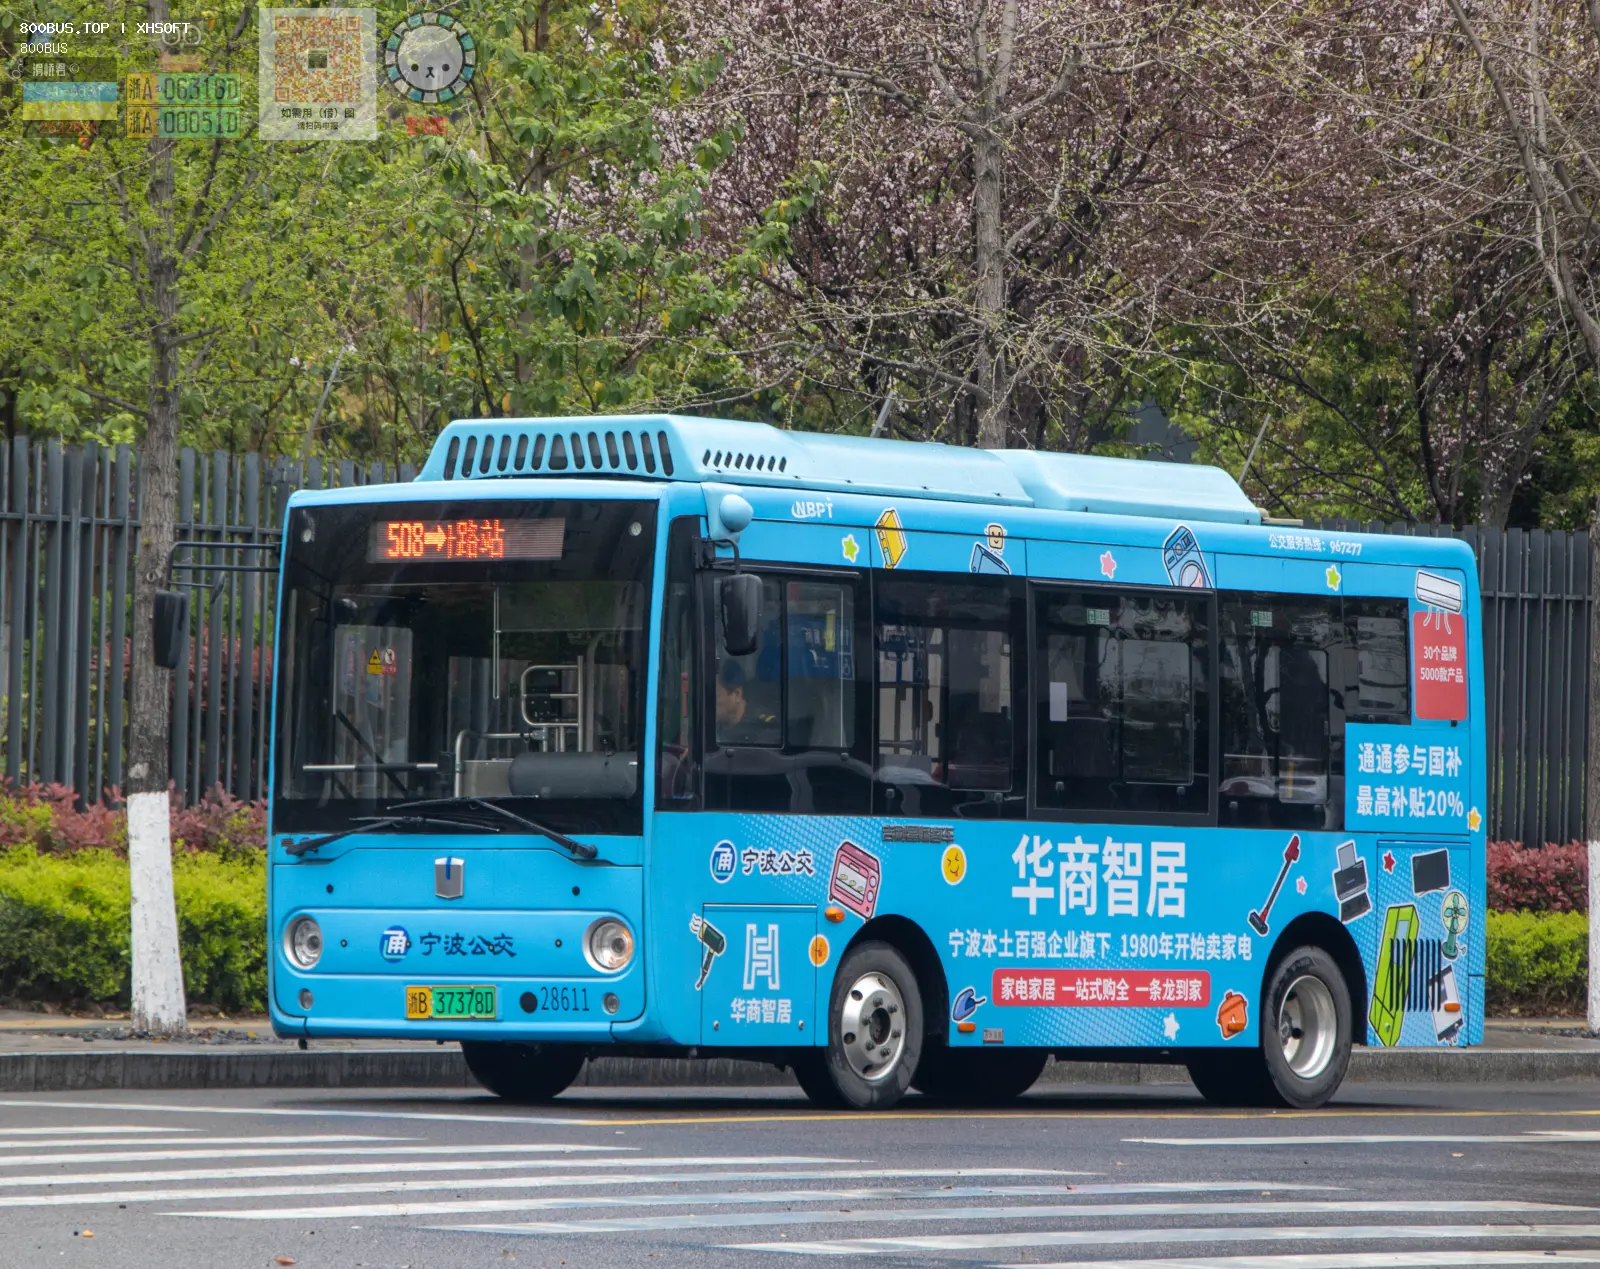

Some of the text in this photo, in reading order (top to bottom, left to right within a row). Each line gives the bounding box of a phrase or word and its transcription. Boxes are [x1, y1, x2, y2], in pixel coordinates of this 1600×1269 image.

[387, 521, 424, 558] 508
[1423, 645, 1458, 662] 30个品牌
[1420, 666, 1464, 683] 5000款产品
[1357, 742, 1463, 777] 通通参与国补
[1356, 785, 1464, 819] 最高补贴20%
[741, 848, 815, 876] 宁波公交
[1011, 833, 1188, 918] 华商智居
[419, 932, 517, 958] 宁波公交
[948, 928, 1253, 961] 宁波本土百强企业旗下 1980年开始卖家电
[540, 986, 590, 1012] 28611
[1001, 976, 1203, 1002] 家电家居 一站式购全 一条龙到家
[730, 997, 792, 1024] 华商智居
